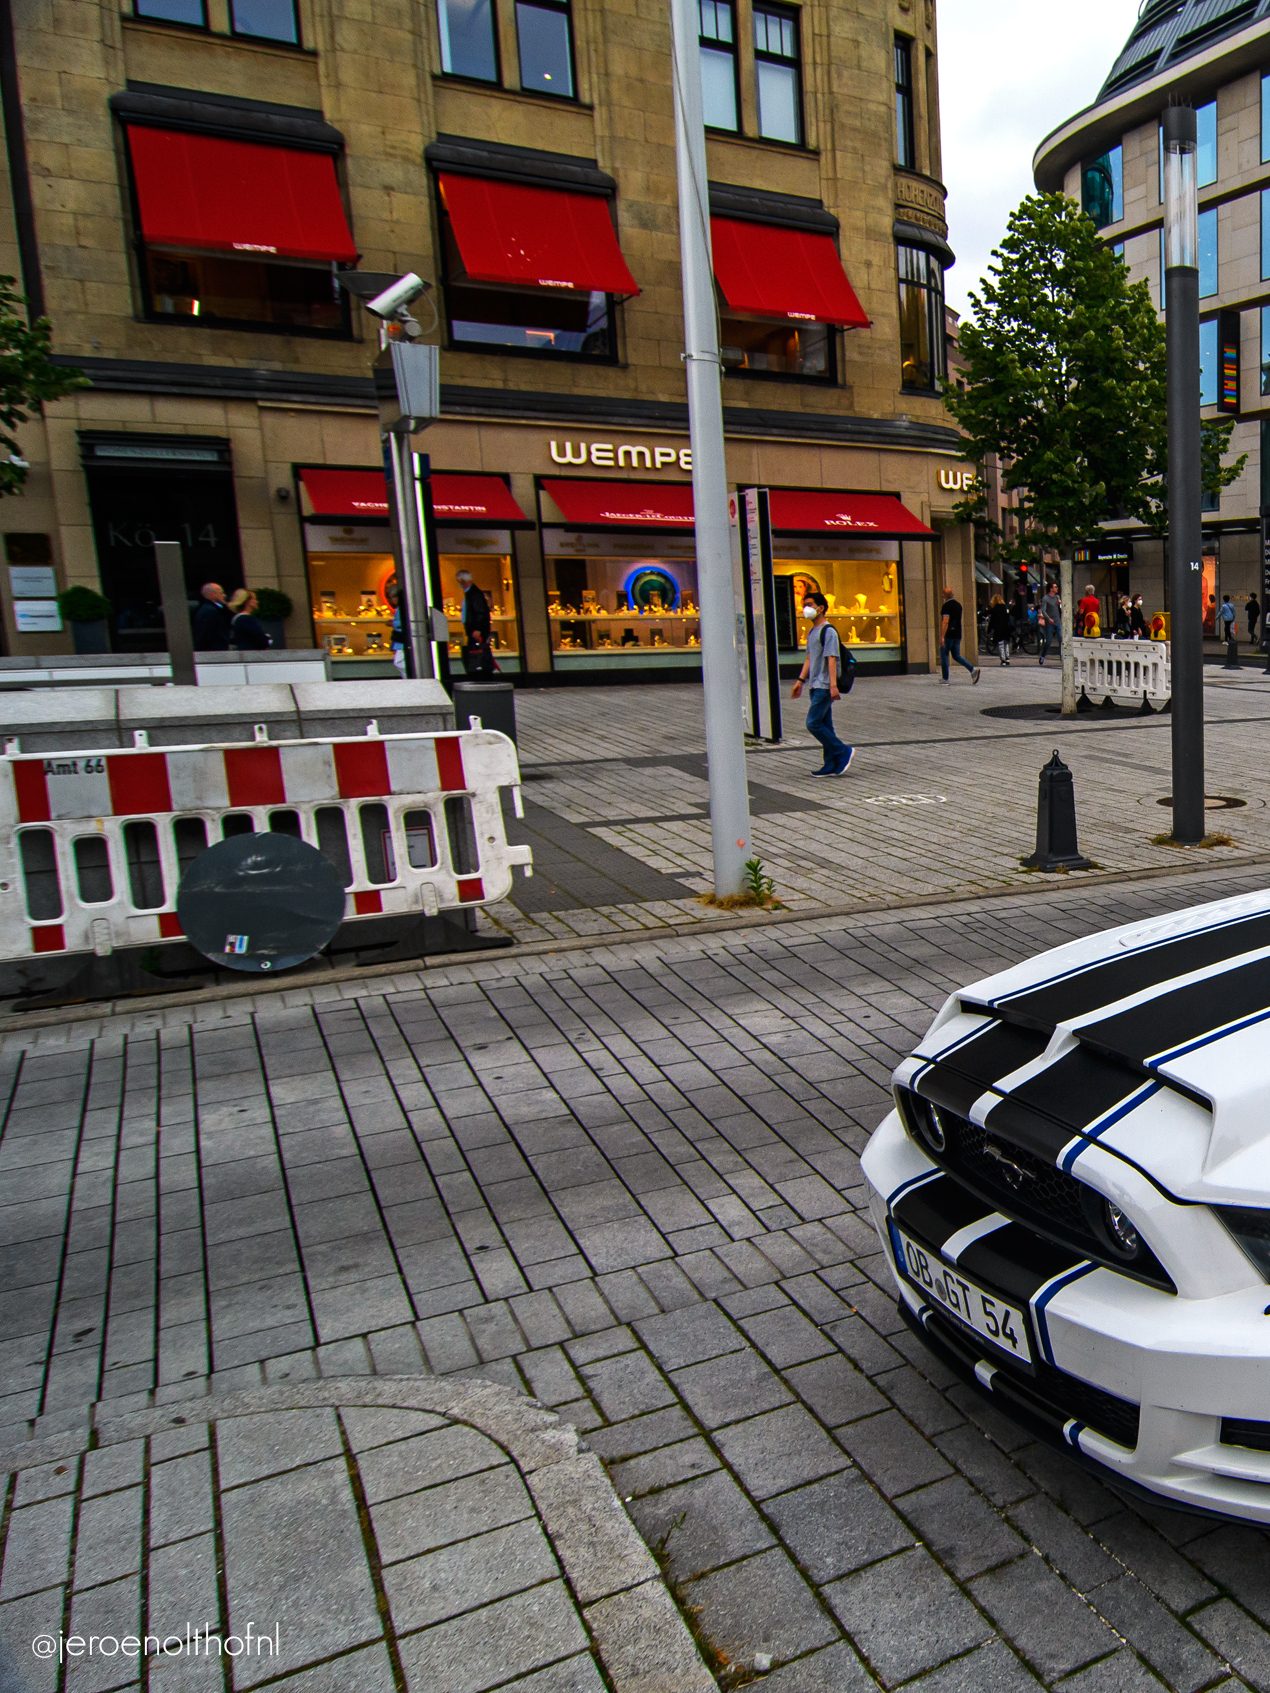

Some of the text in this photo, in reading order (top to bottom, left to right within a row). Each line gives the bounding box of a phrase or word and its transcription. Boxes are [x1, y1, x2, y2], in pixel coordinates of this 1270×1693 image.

[232, 242, 277, 254] WEMPE
[538, 278, 575, 289] WEMPE
[787, 311, 816, 321] WEMPE
[549, 440, 693, 471] WEMPE
[351, 501, 487, 513] VACHE NSTANTIN
[823, 519, 879, 528] ROLEX
[181, 522, 218, 547] 14
[1190, 562, 1199, 571] 14
[43, 758, 105, 775] Amt 66
[906, 1240, 934, 1289] OB
[942, 1269, 972, 1322] GT
[981, 1294, 1019, 1350] 54
